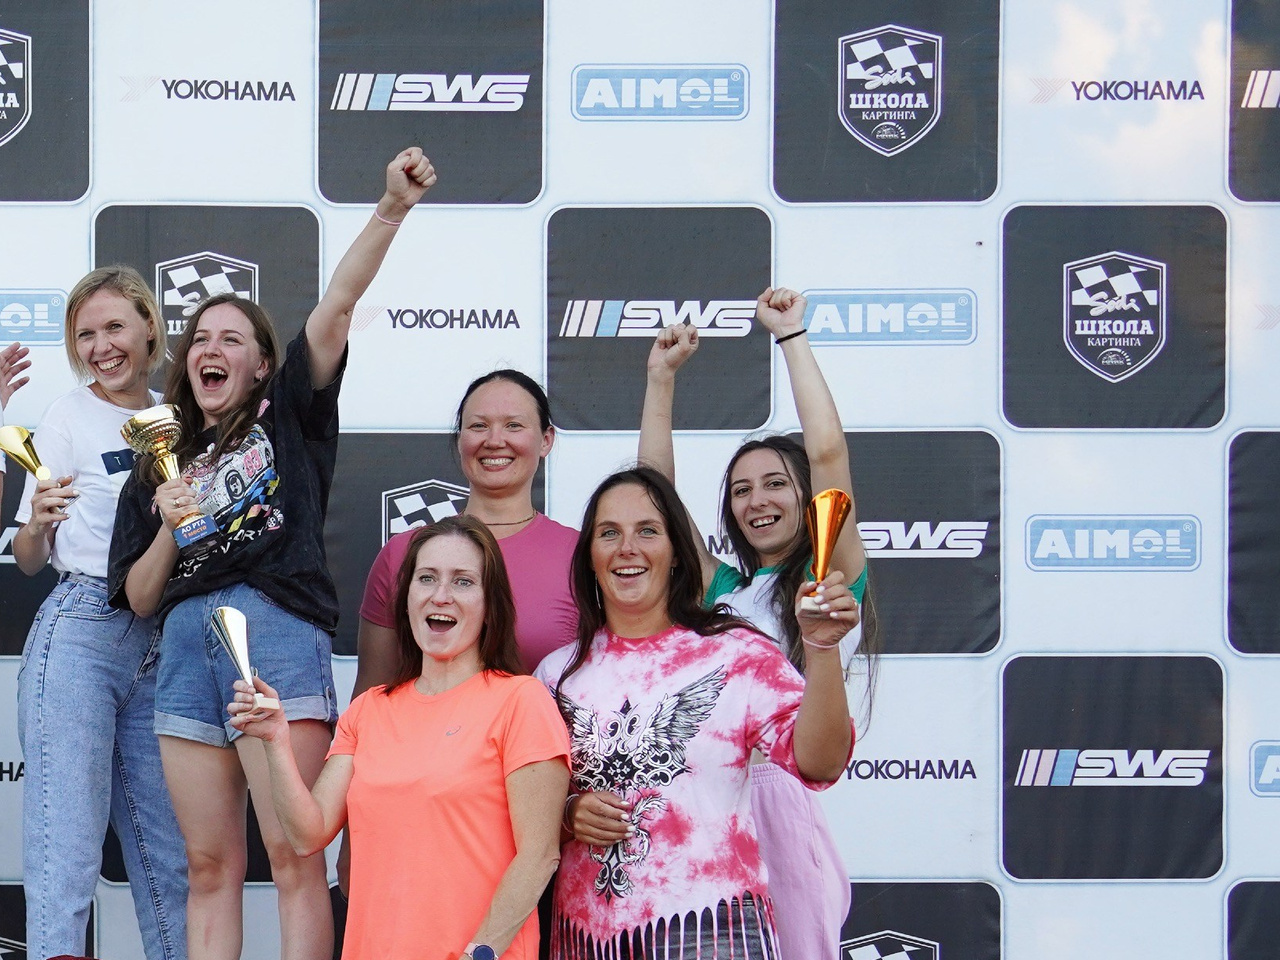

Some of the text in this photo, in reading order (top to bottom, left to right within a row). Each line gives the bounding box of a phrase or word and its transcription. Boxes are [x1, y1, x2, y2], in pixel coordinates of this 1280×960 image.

[162, 80, 295, 100] YOKOHAMA
[391, 74, 529, 111] SWS
[580, 77, 740, 108] AIMOL
[1072, 81, 1204, 100] YOKOHAMA
[849, 93, 929, 109] ШКОЛА
[862, 111, 916, 120] КАРТИНГА
[387, 309, 520, 328] YOKOHAMA
[618, 300, 757, 337] SWS
[807, 303, 967, 333] AIMOL
[1074, 320, 1154, 335] ШКОЛА
[1087, 338, 1141, 347] КАРТИНГА
[856, 522, 988, 558] SWS
[1034, 531, 1192, 559] AIMOL
[846, 760, 977, 780] YOKOHAMA
[1073, 750, 1210, 786] SWS
